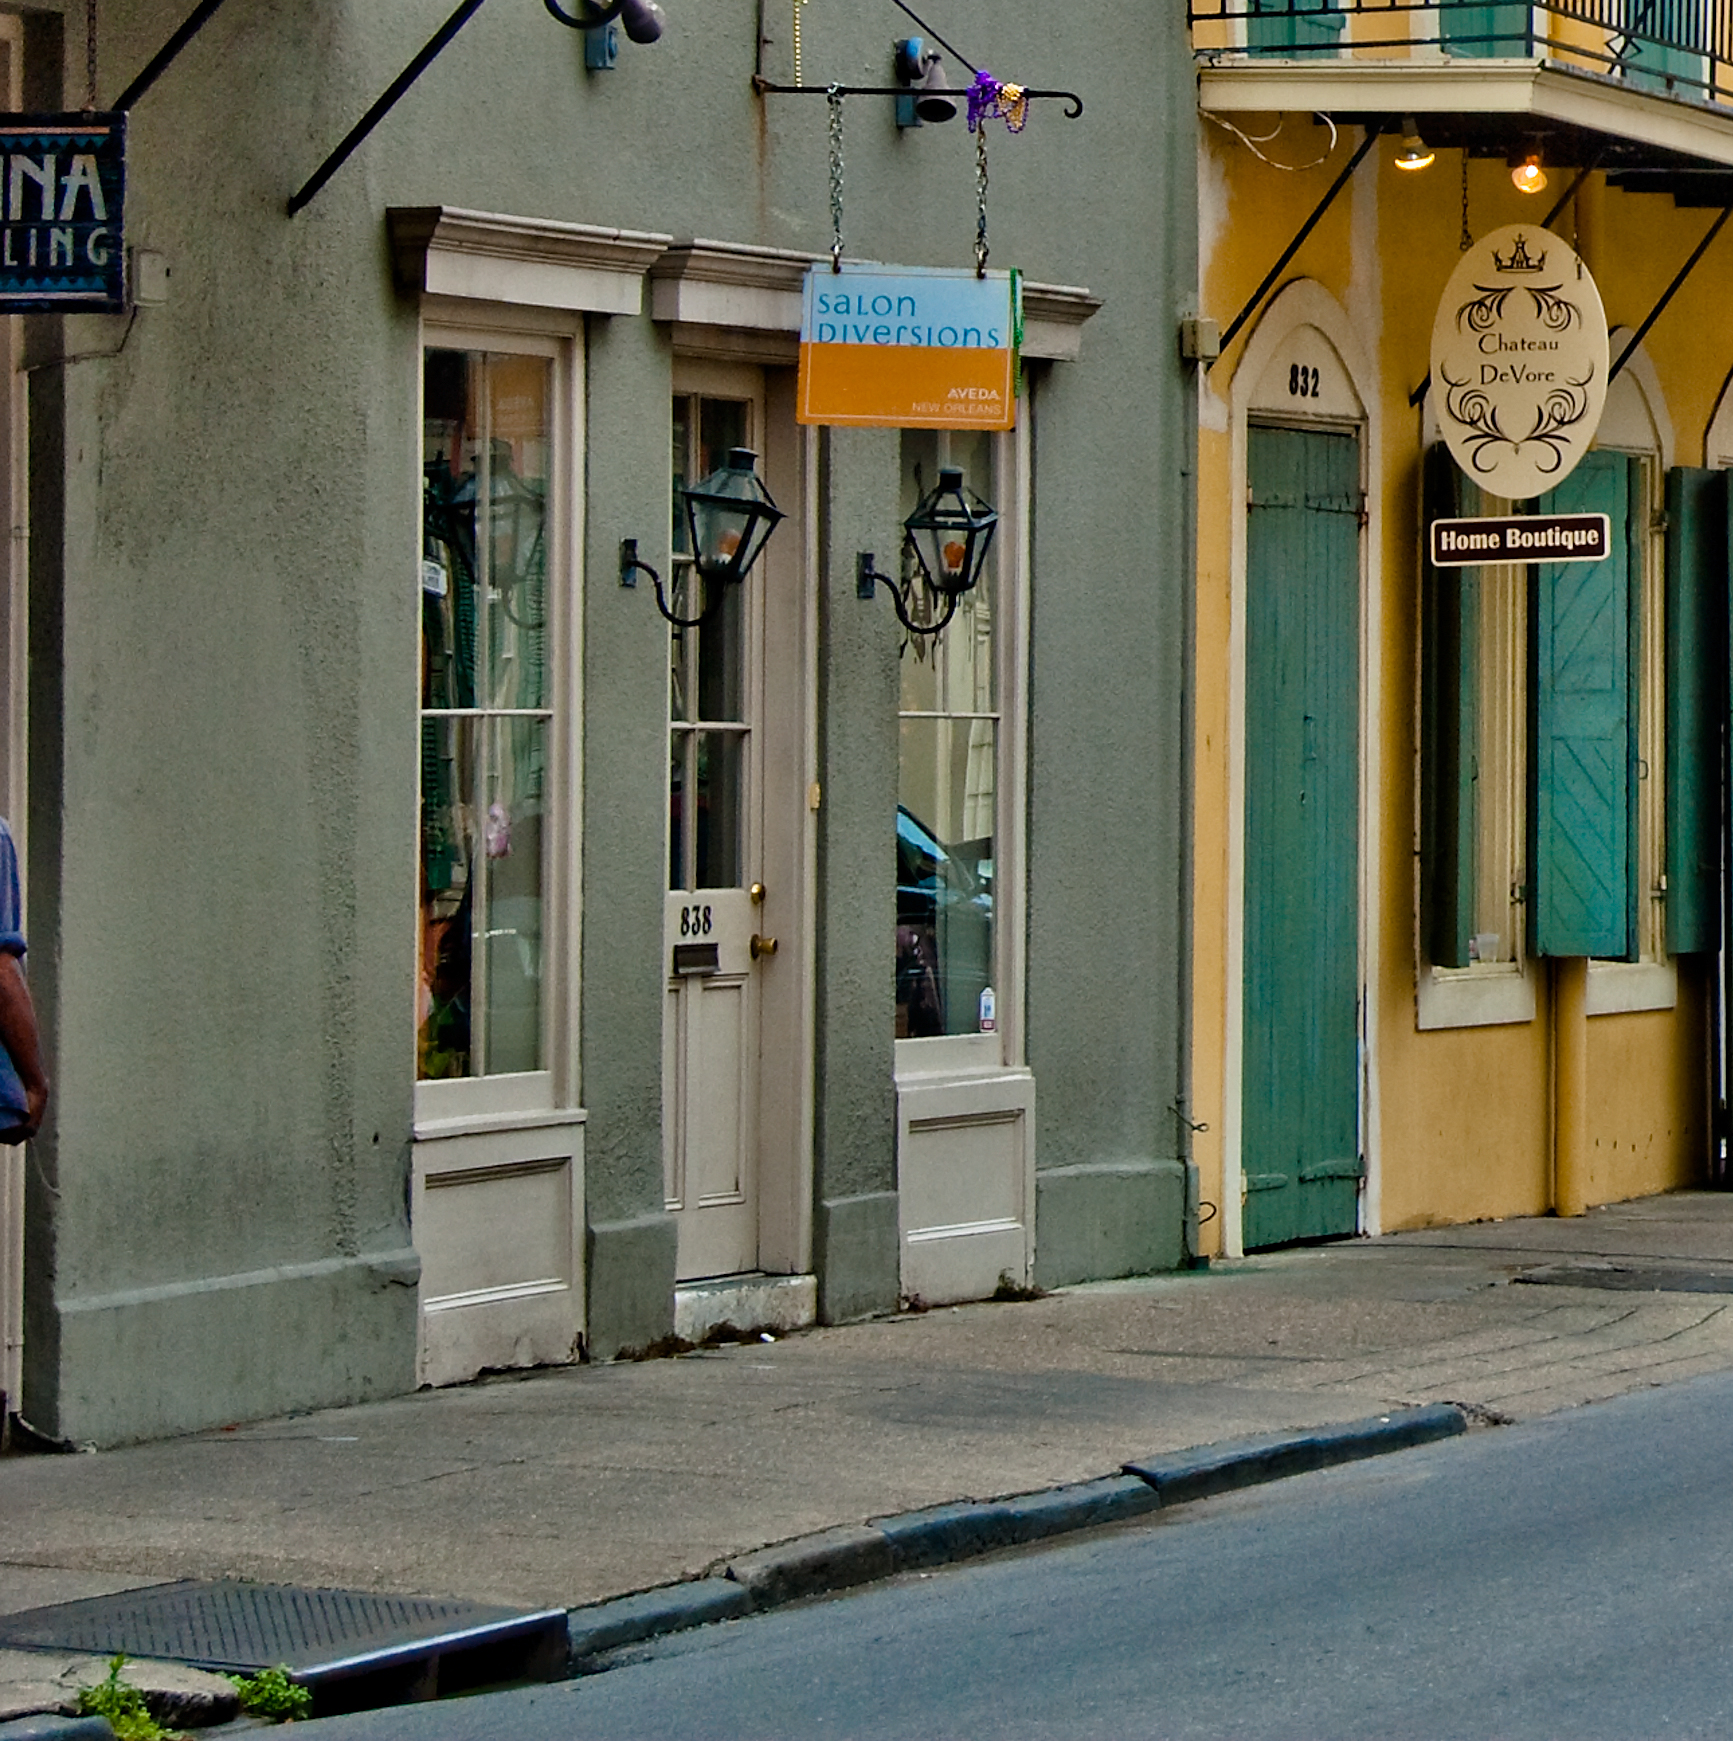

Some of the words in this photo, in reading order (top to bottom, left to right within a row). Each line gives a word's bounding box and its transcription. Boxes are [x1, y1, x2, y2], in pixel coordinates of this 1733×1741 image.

[0, 154, 108, 221] NA
[1477, 332, 1560, 355] Chateau
[1288, 363, 1320, 397] 832
[1479, 364, 1556, 386] DeVore
[947, 387, 1001, 400] AVEDA
[912, 402, 941, 413] NEW
[943, 403, 1002, 415] ORLEANS
[1440, 531, 1501, 552] Home
[1505, 526, 1600, 551] Boutique
[680, 905, 713, 936] 838
